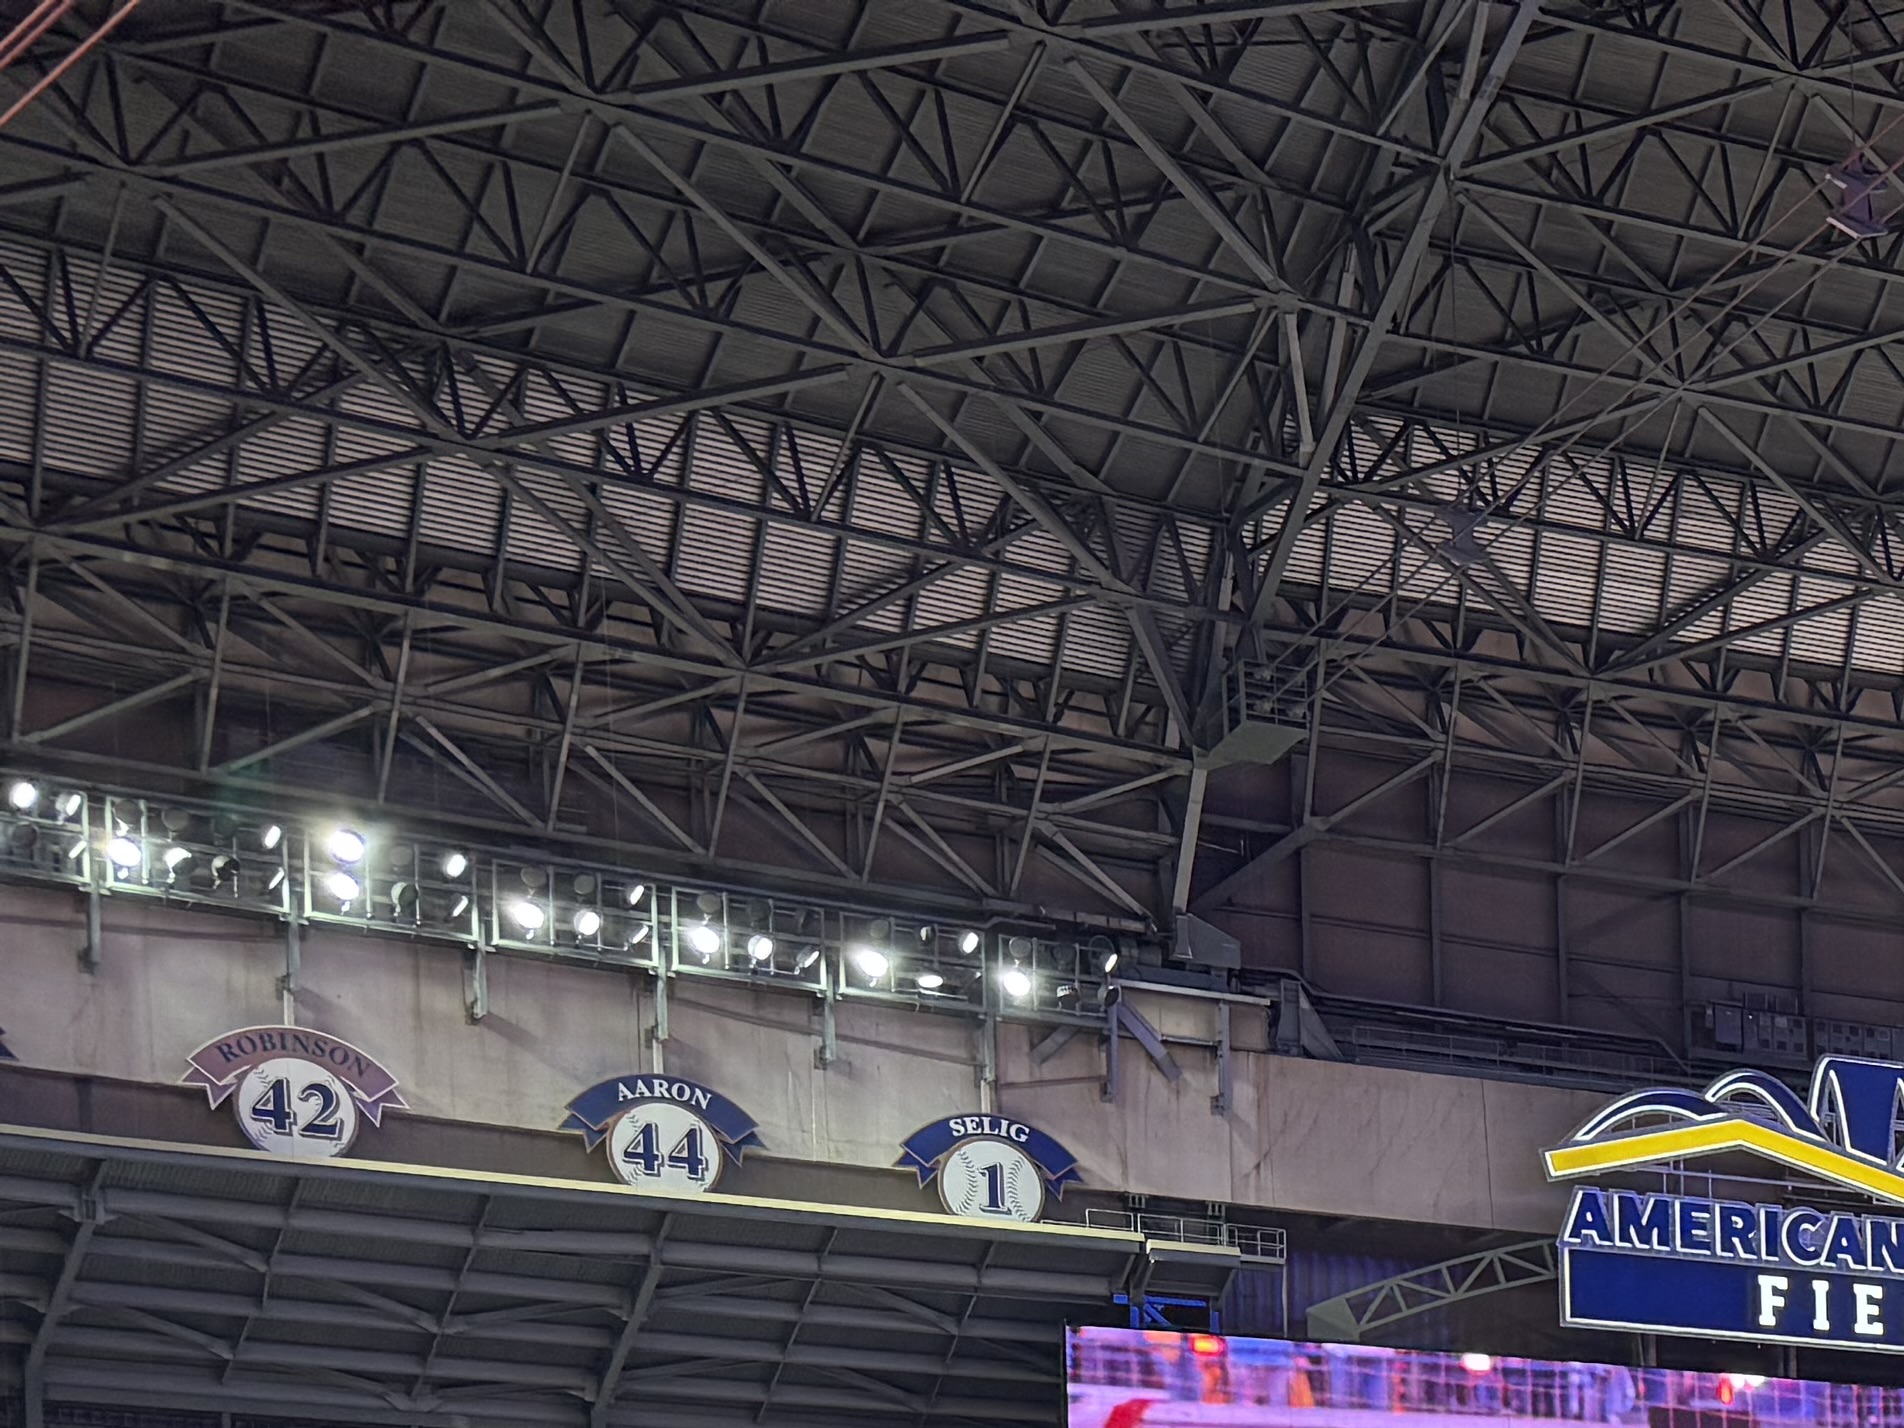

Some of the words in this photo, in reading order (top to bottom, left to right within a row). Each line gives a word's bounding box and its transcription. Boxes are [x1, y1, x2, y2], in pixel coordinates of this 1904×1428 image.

[216, 1031, 371, 1078] ROBINSON
[251, 1077, 345, 1140] 42
[618, 1078, 713, 1111] AARON
[623, 1121, 708, 1181] 44
[949, 1116, 1030, 1143] SELIG
[978, 1161, 1012, 1215] 1
